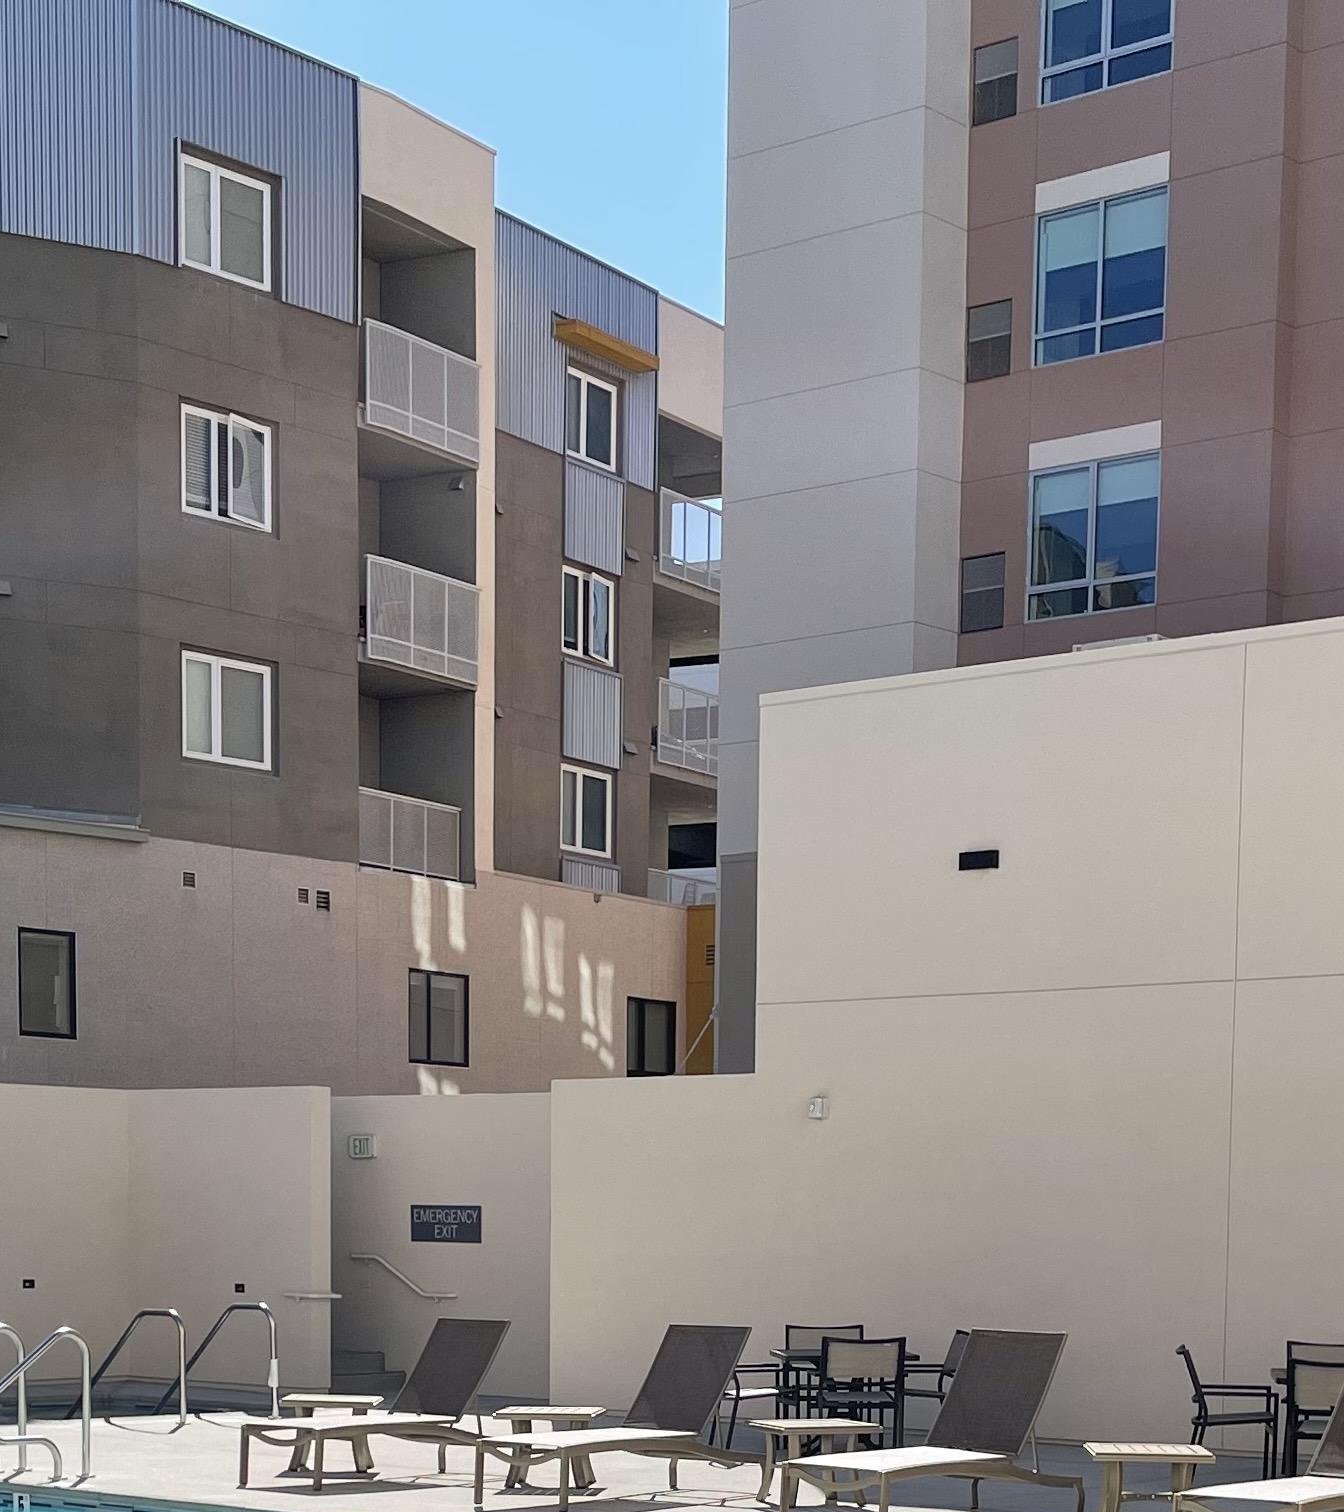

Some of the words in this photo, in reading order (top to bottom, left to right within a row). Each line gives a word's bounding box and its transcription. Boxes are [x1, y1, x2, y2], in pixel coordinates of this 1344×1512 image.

[353, 1137, 370, 1156] EXIT
[413, 1208, 479, 1224] EMERGENCY
[434, 1224, 459, 1239] EXIT
